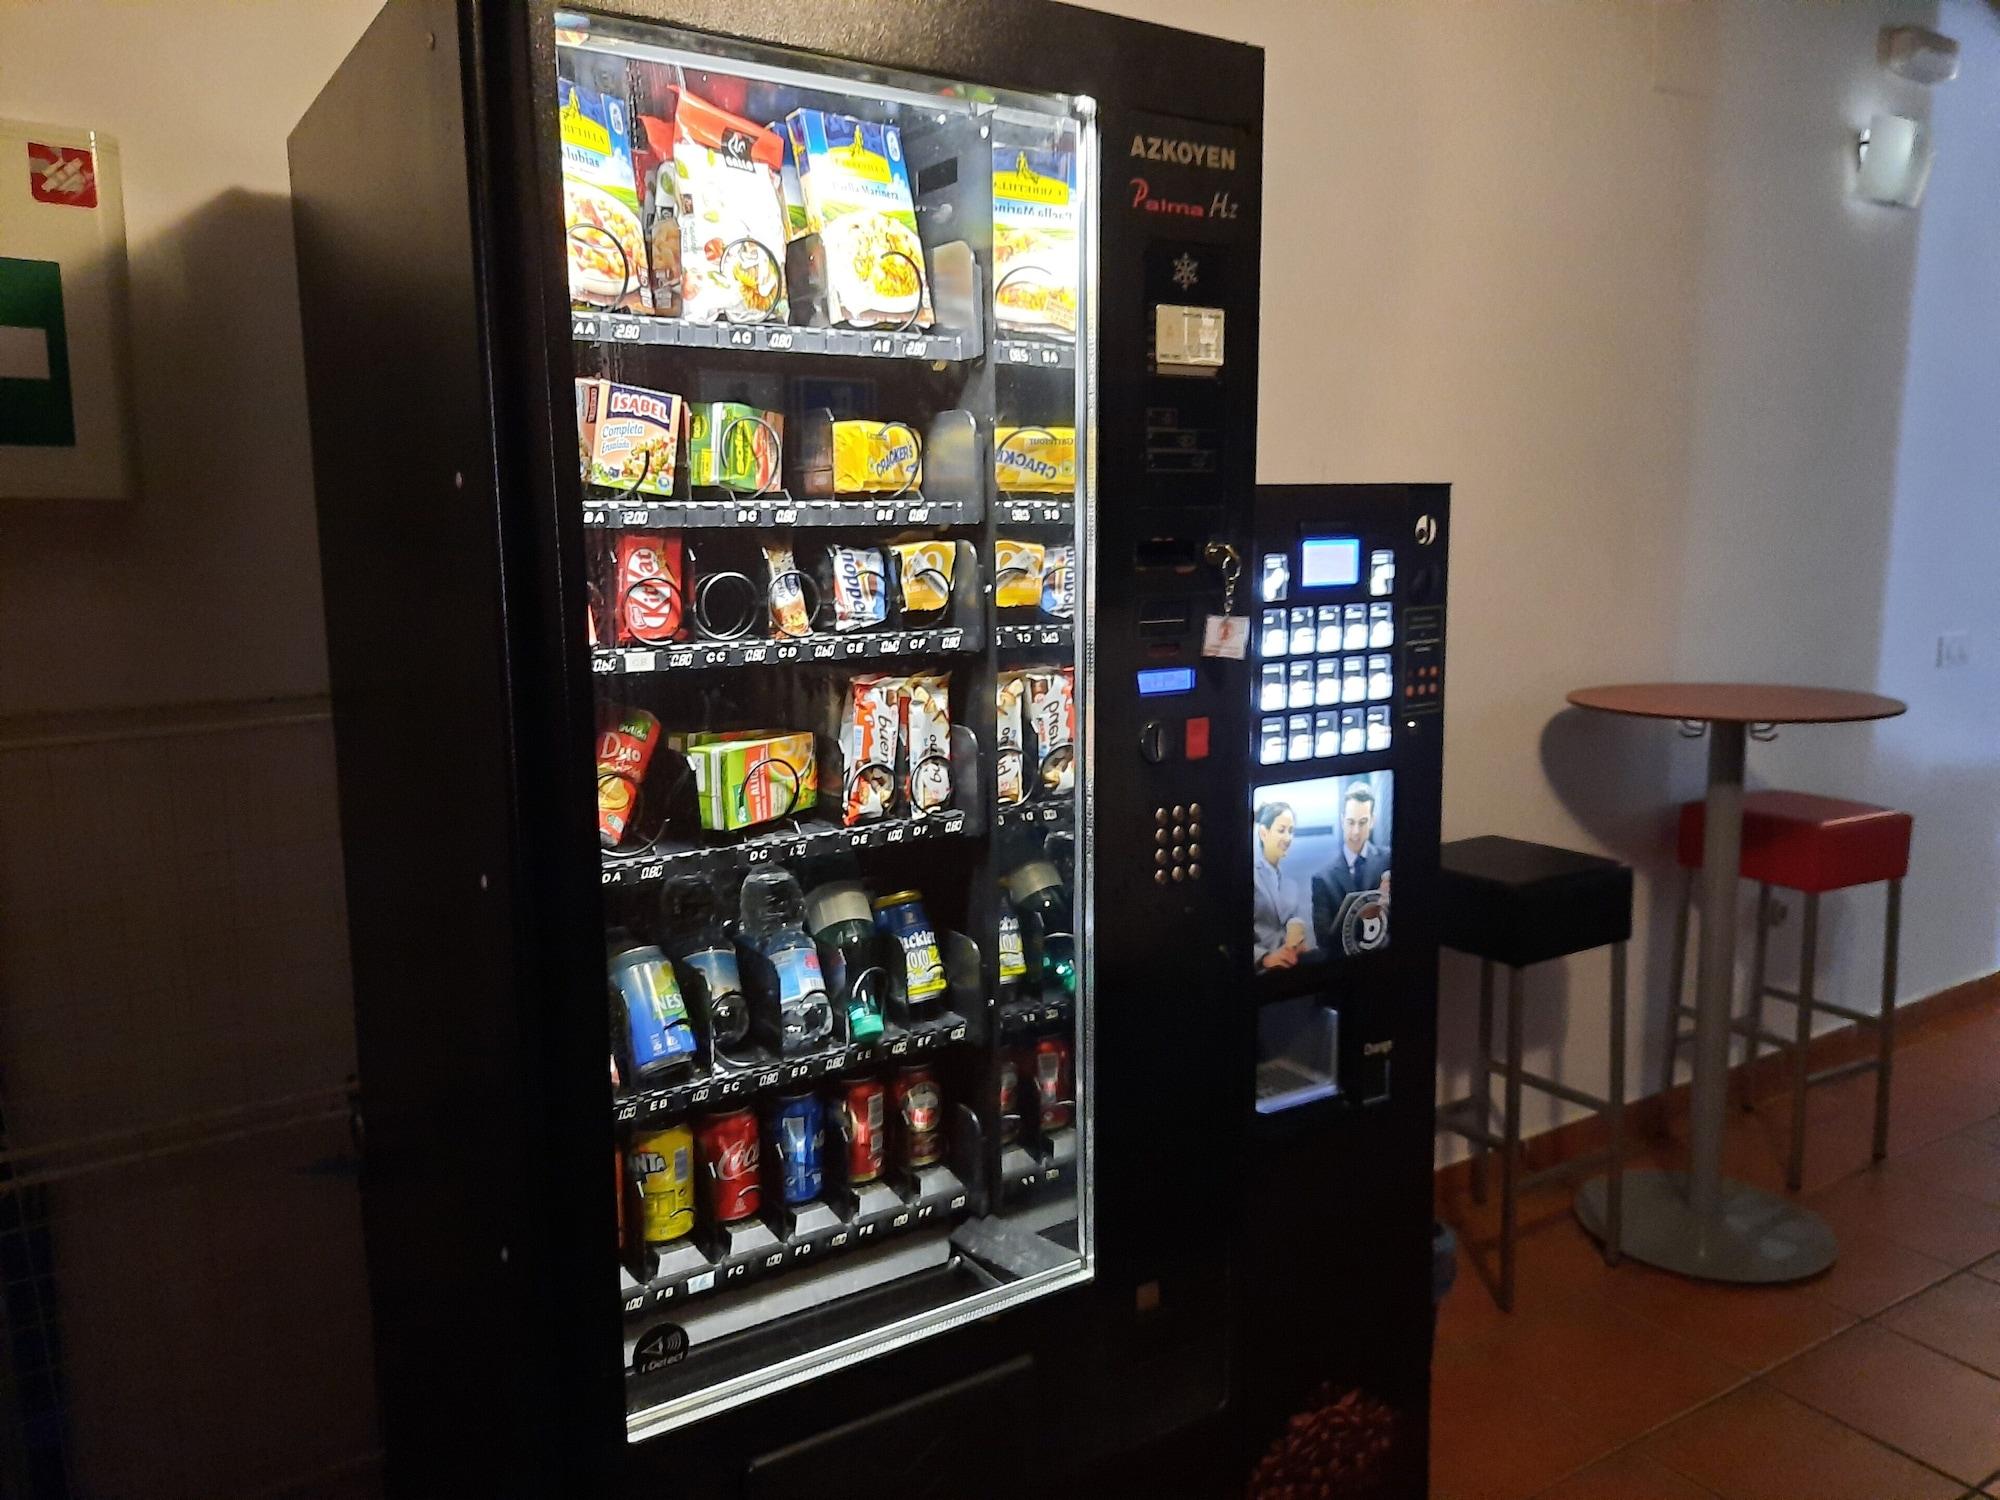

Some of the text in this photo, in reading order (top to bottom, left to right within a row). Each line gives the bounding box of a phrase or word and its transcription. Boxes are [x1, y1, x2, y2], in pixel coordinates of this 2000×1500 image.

[1130, 135, 1236, 170] AZKOYEN
[1130, 178, 1239, 219] Palma Hz
[611, 393, 669, 419] ISABEL
[602, 422, 644, 438] Completa
[706, 652, 726, 663] CC
[778, 647, 798, 658] CD
[909, 638, 926, 650] CF
[601, 732, 642, 762] Duo
[928, 734, 942, 784] buno
[602, 872, 621, 883] DA
[749, 850, 768, 861] DC
[851, 833, 868, 845] DE
[913, 825, 929, 836] DF
[650, 1100, 667, 1111] EB
[723, 1082, 740, 1093] EC
[791, 1066, 808, 1078] ED
[917, 1036, 931, 1047] EF
[656, 1287, 673, 1300] FB
[727, 1265, 745, 1278] FC
